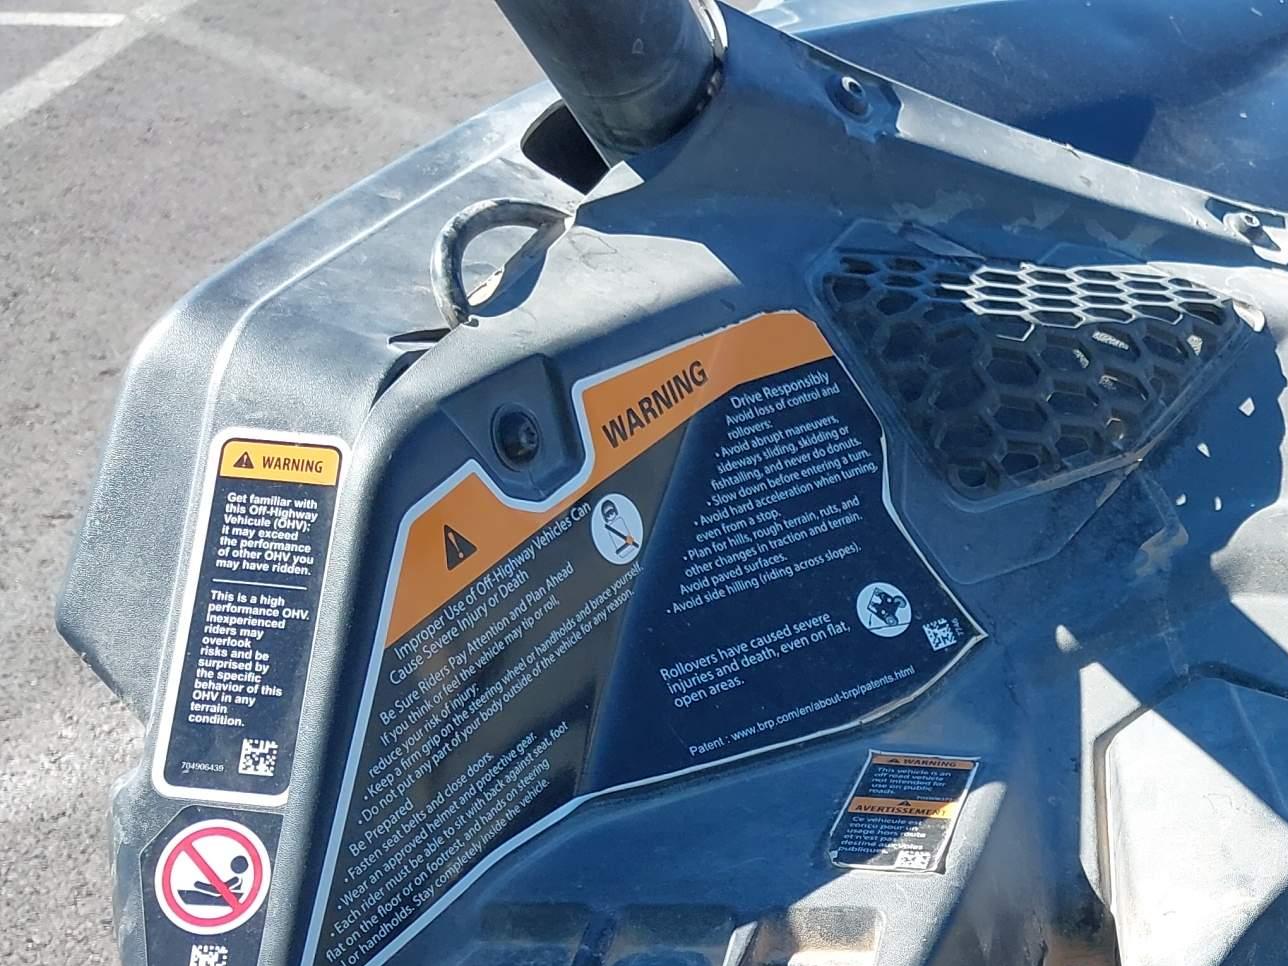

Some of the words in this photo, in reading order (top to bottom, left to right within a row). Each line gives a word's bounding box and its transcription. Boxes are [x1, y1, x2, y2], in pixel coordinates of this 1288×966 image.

[729, 391, 763, 409] Drive
[761, 371, 829, 399] Responsibly
[601, 360, 709, 449] WARNING
[725, 407, 755, 426] Avoid
[753, 404, 775, 417] loss
[775, 397, 786, 410] of
[786, 388, 821, 407] control
[821, 382, 840, 397] and
[720, 439, 750, 458] Avoid
[751, 429, 785, 448] abrupt
[784, 415, 839, 438] maneuvers,
[727, 420, 773, 440] rollovers:
[717, 453, 762, 474] sideways
[762, 442, 798, 459] sliding,
[797, 429, 839, 449] skidding
[838, 425, 849, 435] or
[262, 456, 323, 473] WARNING
[710, 468, 764, 491] fishtailing,
[763, 459, 784, 474] and
[783, 452, 811, 468] never
[812, 447, 826, 459] do
[826, 437, 862, 454] donuts.
[711, 491, 737, 506] Slow
[737, 481, 768, 498] down
[765, 471, 801, 488] before
[800, 458, 842, 477] entering
[847, 449, 871, 462] turn.
[227, 492, 248, 503] Get
[249, 494, 292, 507] familiar
[293, 498, 317, 510] with
[699, 507, 730, 526] Avoid
[728, 499, 754, 516] hard
[754, 482, 814, 508] acceleration
[812, 473, 841, 488] when
[840, 462, 878, 480] turning,
[225, 503, 246, 514] this
[246, 505, 318, 523] Off-Highway
[223, 514, 271, 527] Vehicule
[273, 518, 311, 532] (OHV):
[695, 527, 722, 542] even
[720, 519, 748, 534] from
[755, 509, 781, 523] stop.
[221, 525, 230, 535] it
[231, 527, 256, 539] may
[257, 529, 299, 541] exceed
[219, 536, 238, 546] the
[239, 538, 311, 553] performance
[217, 547, 231, 557] of
[231, 548, 262, 559] other
[263, 550, 291, 562] OHV
[291, 555, 314, 565] you
[215, 559, 240, 571] may
[241, 560, 269, 571] have
[271, 563, 311, 575] ridden.
[393, 614, 445, 660] Improper
[443, 599, 466, 620] Use
[465, 586, 477, 605] of
[476, 543, 535, 595] Off-Highway
[531, 515, 572, 550] Vehicles
[570, 501, 596, 521] Can
[210, 590, 234, 602] This
[236, 592, 247, 603] is
[259, 594, 285, 607] high
[205, 612, 286, 629] Inexperienced
[207, 603, 279, 617] performance
[281, 608, 309, 620] OHV.
[203, 625, 237, 636] riders
[239, 628, 264, 640] may
[389, 654, 424, 684] Cause
[422, 626, 459, 659] Severe
[456, 602, 488, 631] Injury
[487, 592, 499, 607] or
[497, 569, 529, 599] Death
[201, 636, 251, 648] overlook
[379, 709, 397, 725] Be
[394, 690, 420, 714] Sure
[417, 664, 450, 694] Riders
[447, 650, 467, 670] Pay
[466, 616, 510, 655] Attention
[508, 598, 528, 621] and
[525, 586, 547, 607] Plan
[545, 560, 574, 591] Ahead
[659, 653, 718, 681] Rollovers
[716, 642, 749, 660] have
[749, 624, 792, 648] caused
[792, 613, 831, 634] severe
[199, 646, 228, 657] risks
[230, 650, 253, 659] and
[254, 651, 269, 661] be
[666, 670, 715, 694] injuries
[715, 658, 740, 677] and
[740, 647, 780, 667] death,
[780, 636, 810, 653] even
[810, 629, 827, 642] on
[826, 620, 850, 636] flat,
[197, 658, 253, 674] surprised
[251, 662, 270, 675] by
[196, 668, 214, 679] the
[216, 671, 262, 685] specific
[193, 679, 245, 692] behavior
[246, 684, 260, 694] of
[260, 685, 282, 696] this
[674, 689, 708, 707] open
[708, 676, 744, 695] areas.
[190, 701, 228, 714] terrain
[192, 690, 219, 701] OHV
[220, 692, 232, 703] in
[234, 695, 256, 707] any
[688, 736, 725, 756] Patent
[730, 664, 915, 741] www.brp.com/en/about-brp/patents.html
[188, 713, 244, 727] condition.
[903, 758, 957, 768] WARNING
[348, 840, 367, 856] Be
[364, 796, 414, 844] Prepared
